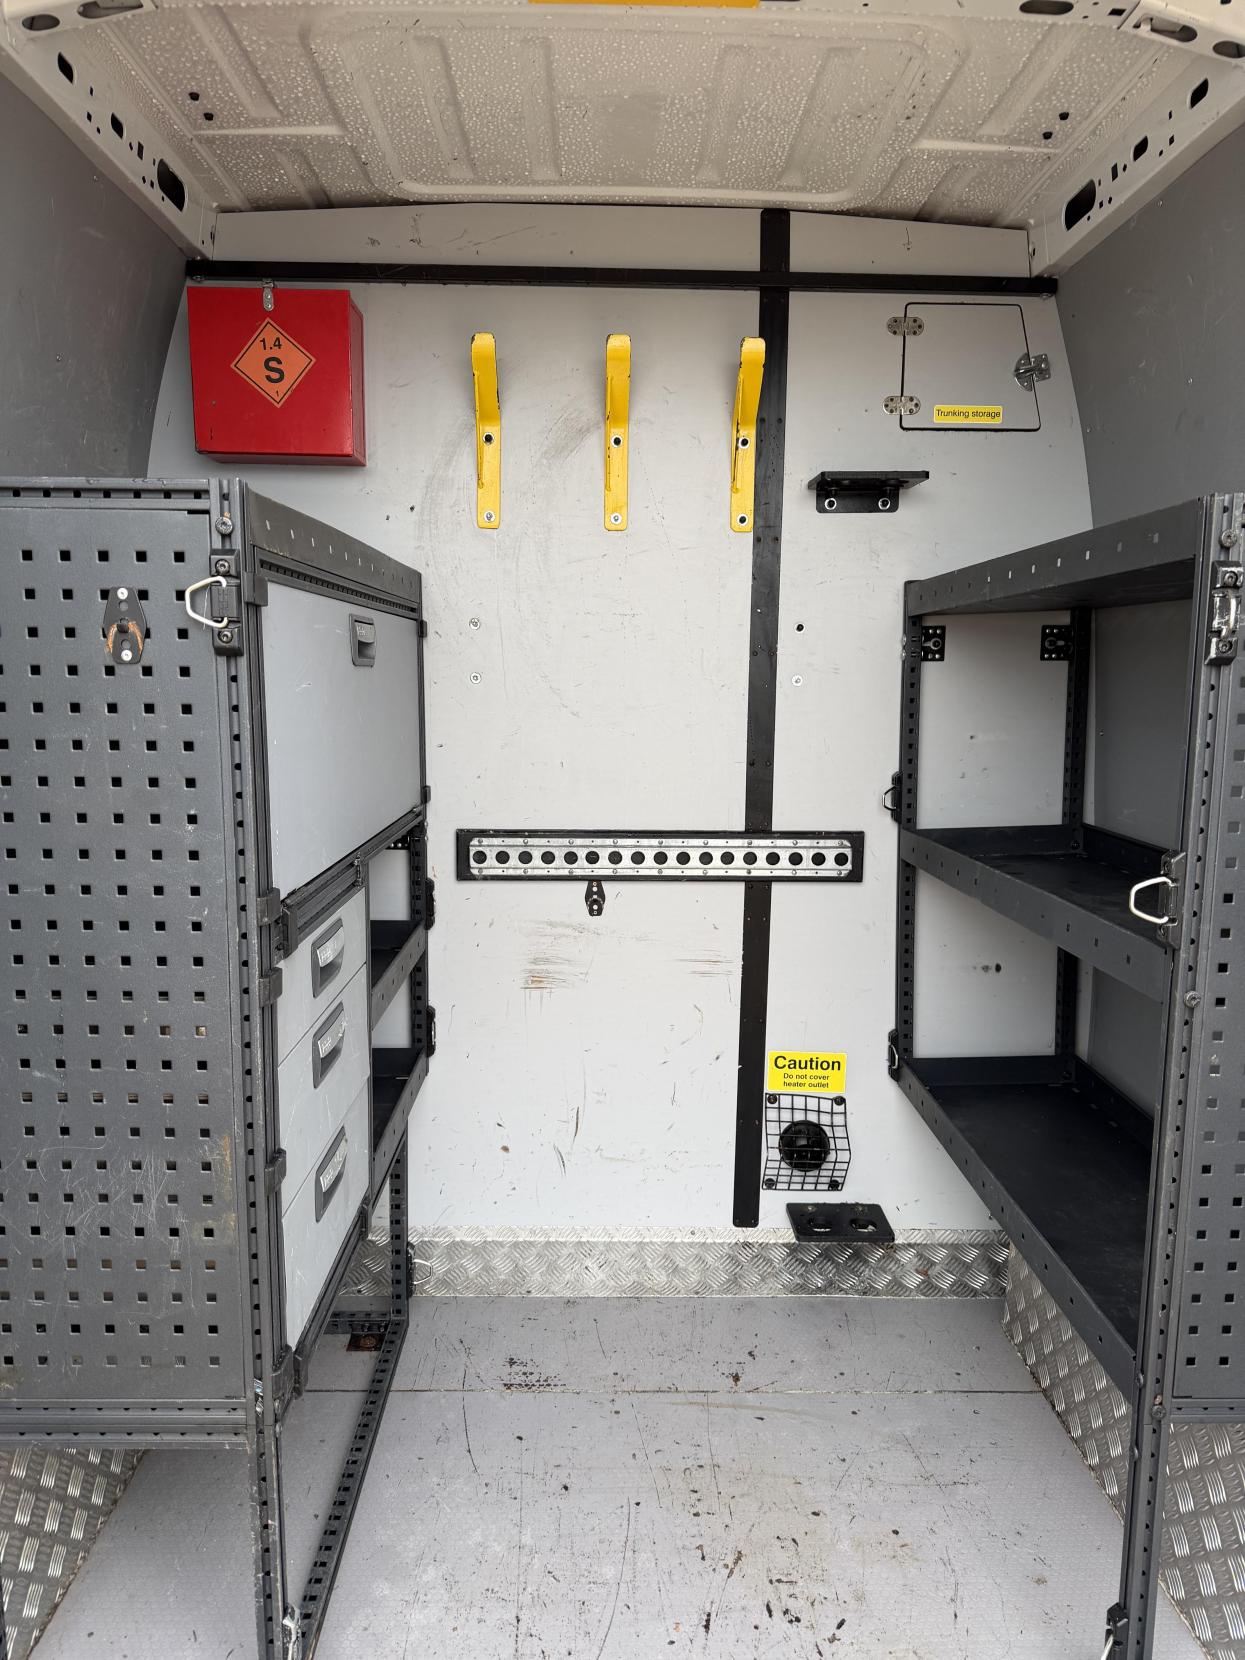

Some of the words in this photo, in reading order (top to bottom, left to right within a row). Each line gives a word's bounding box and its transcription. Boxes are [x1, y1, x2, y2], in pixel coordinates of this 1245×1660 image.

[260, 337, 282, 350] 1.4
[263, 356, 285, 384] S
[936, 409, 969, 419] Trunking
[972, 410, 1001, 419] storage
[774, 1055, 841, 1071] Caution
